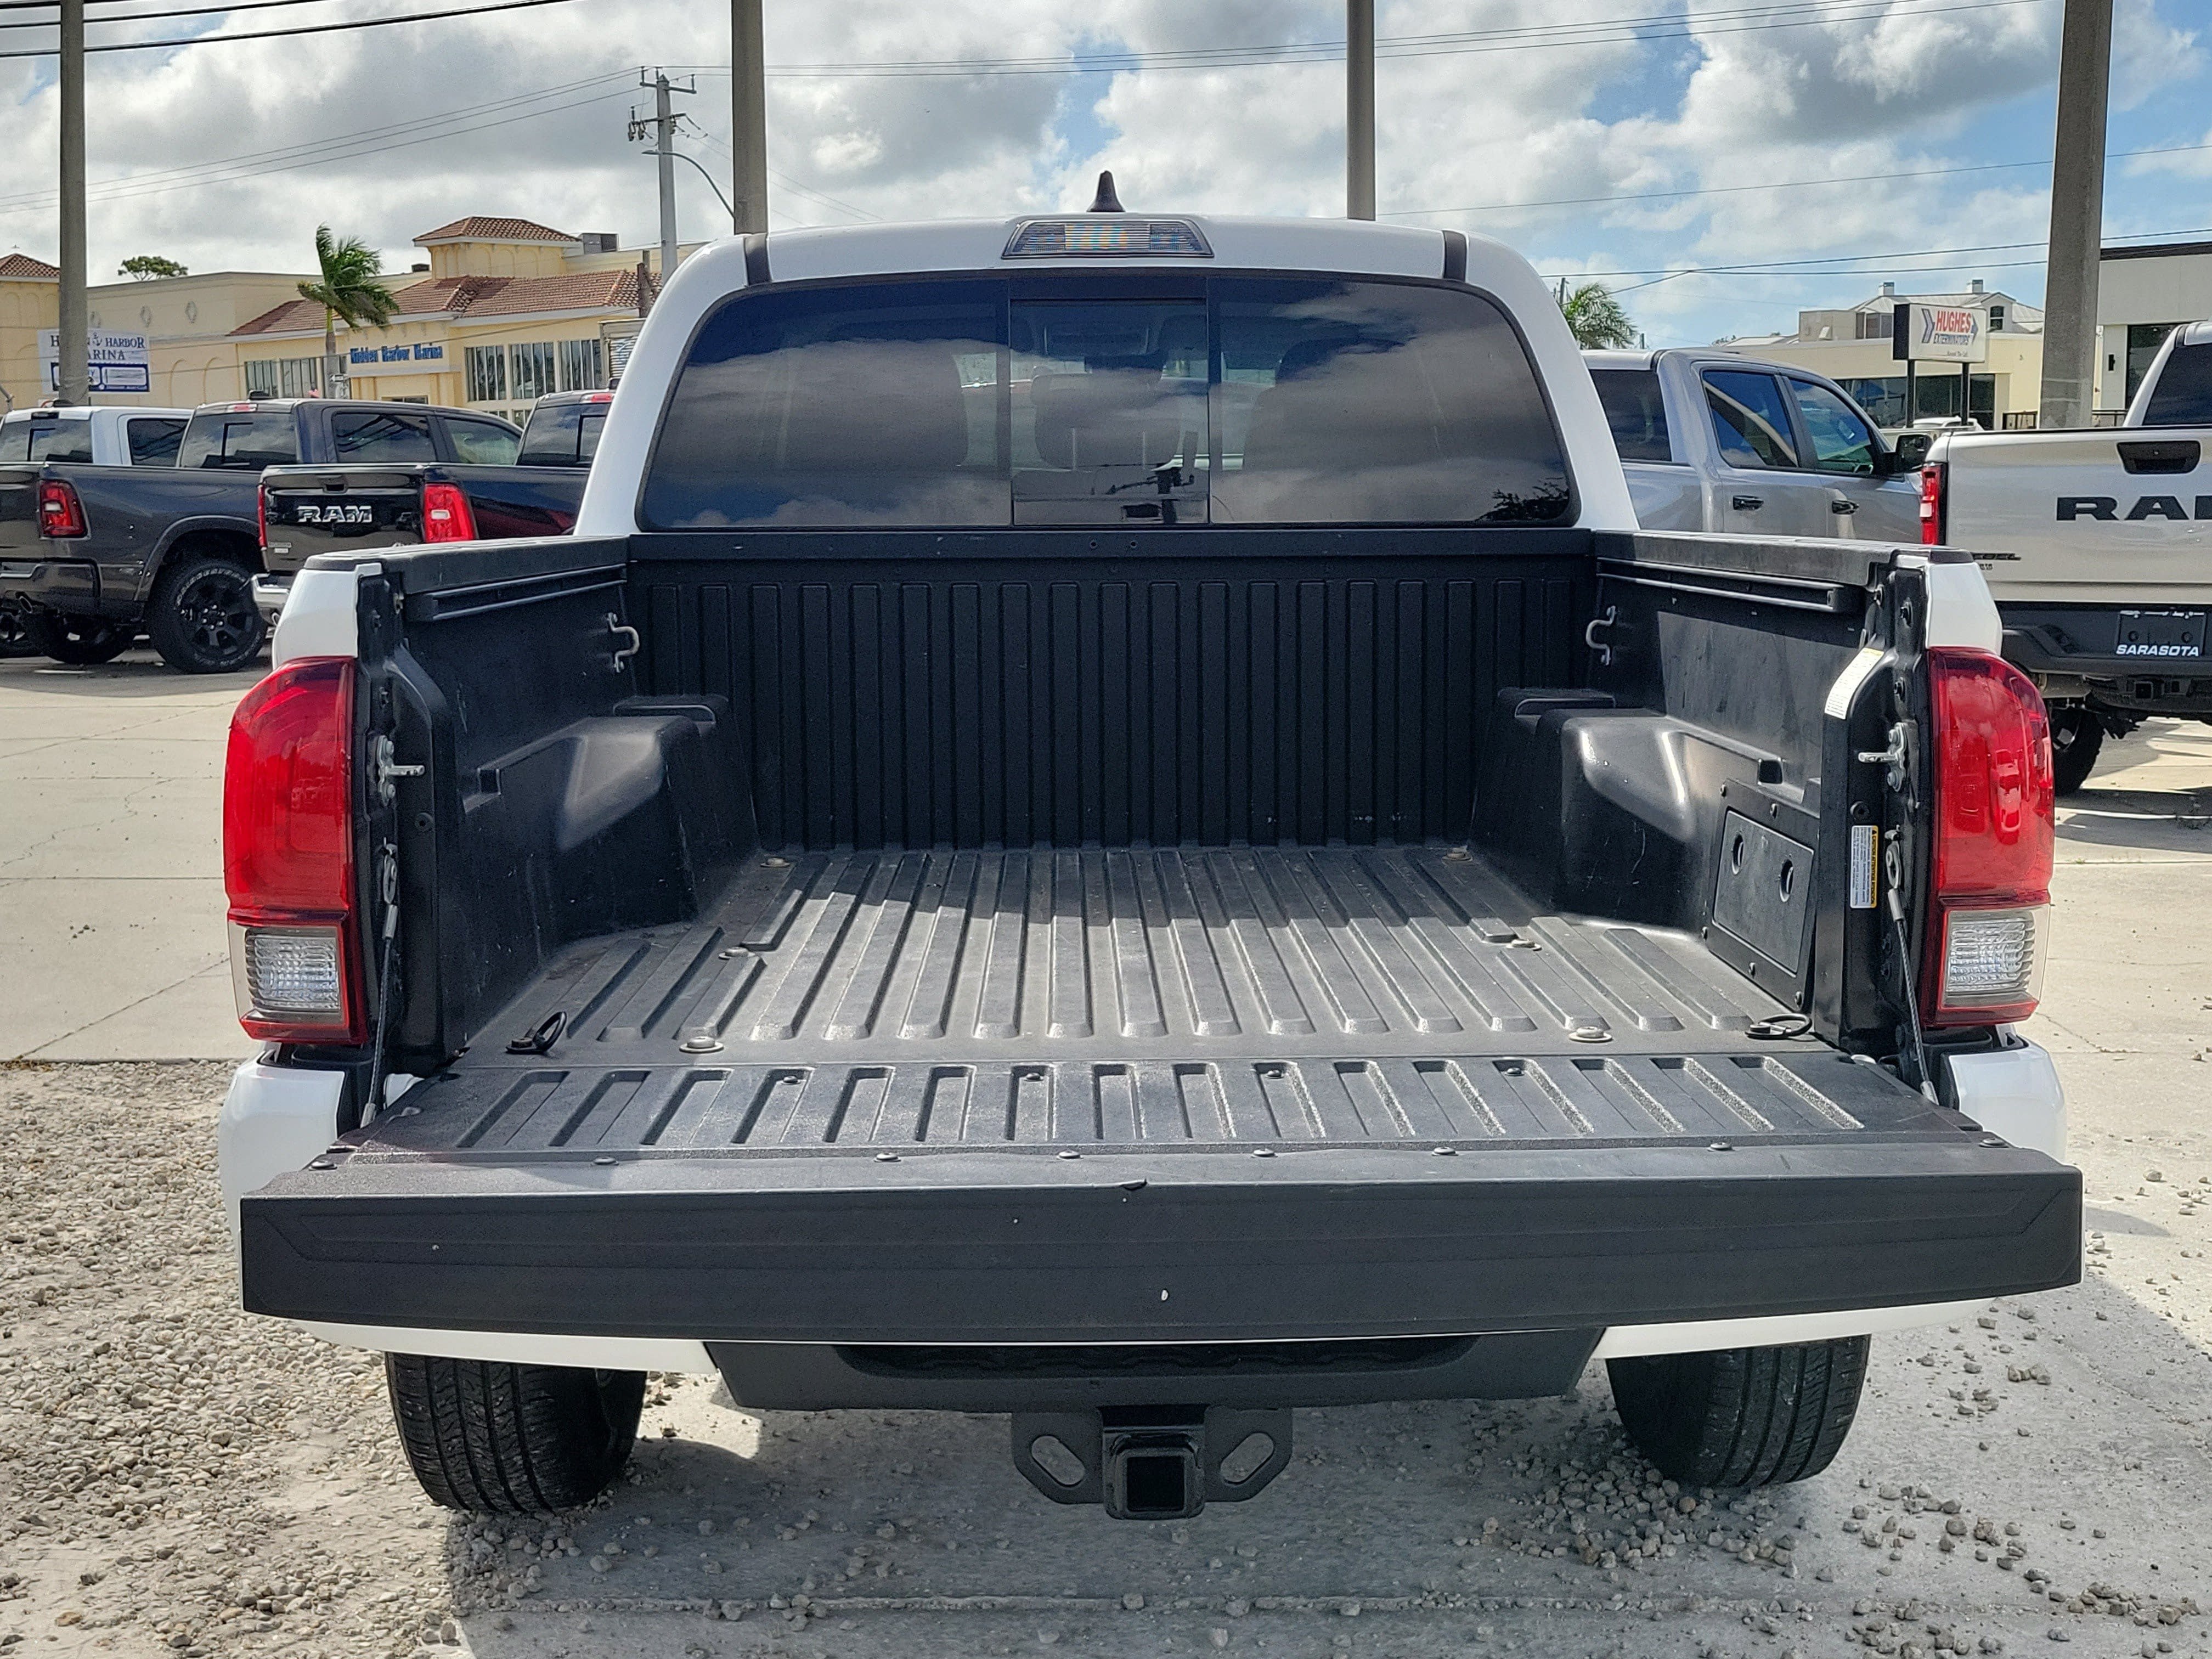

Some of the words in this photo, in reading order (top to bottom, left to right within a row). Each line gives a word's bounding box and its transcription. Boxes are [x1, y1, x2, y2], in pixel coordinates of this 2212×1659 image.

[1936, 311, 1971, 332] HUGHES
[105, 337, 145, 348] HARBOR
[297, 506, 372, 522] RAM
[2057, 496, 2212, 520] RA
[2116, 645, 2199, 656] SARASOTA
